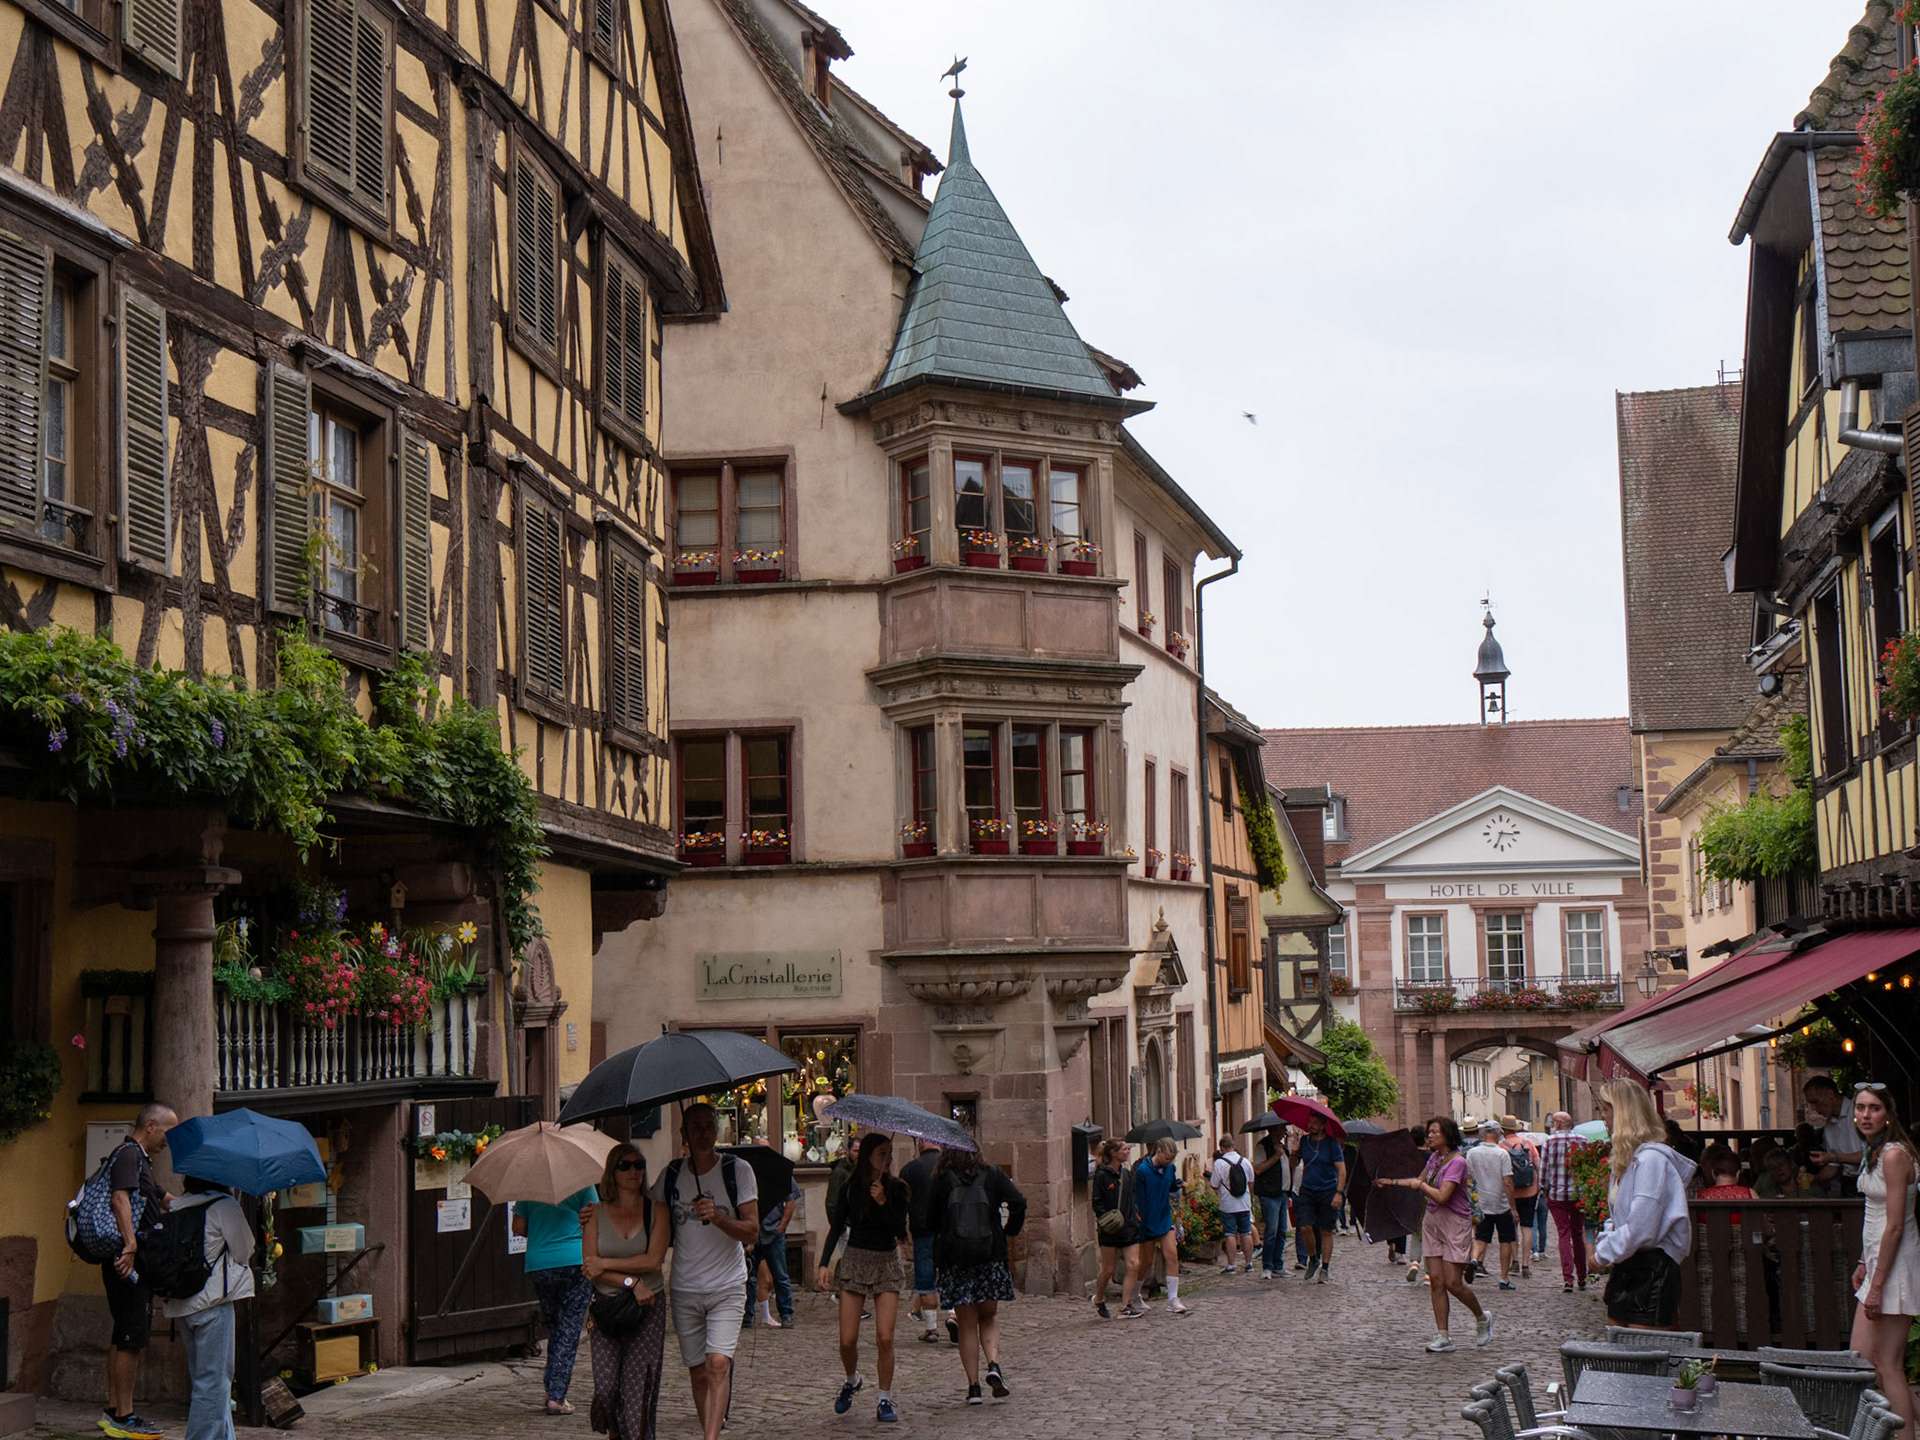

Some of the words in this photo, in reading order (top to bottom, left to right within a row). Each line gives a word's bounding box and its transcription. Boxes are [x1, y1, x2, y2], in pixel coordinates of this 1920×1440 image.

[1430, 884, 1485, 897] HOTEL
[1499, 883, 1519, 896] DE
[1531, 882, 1575, 895] VILLE
